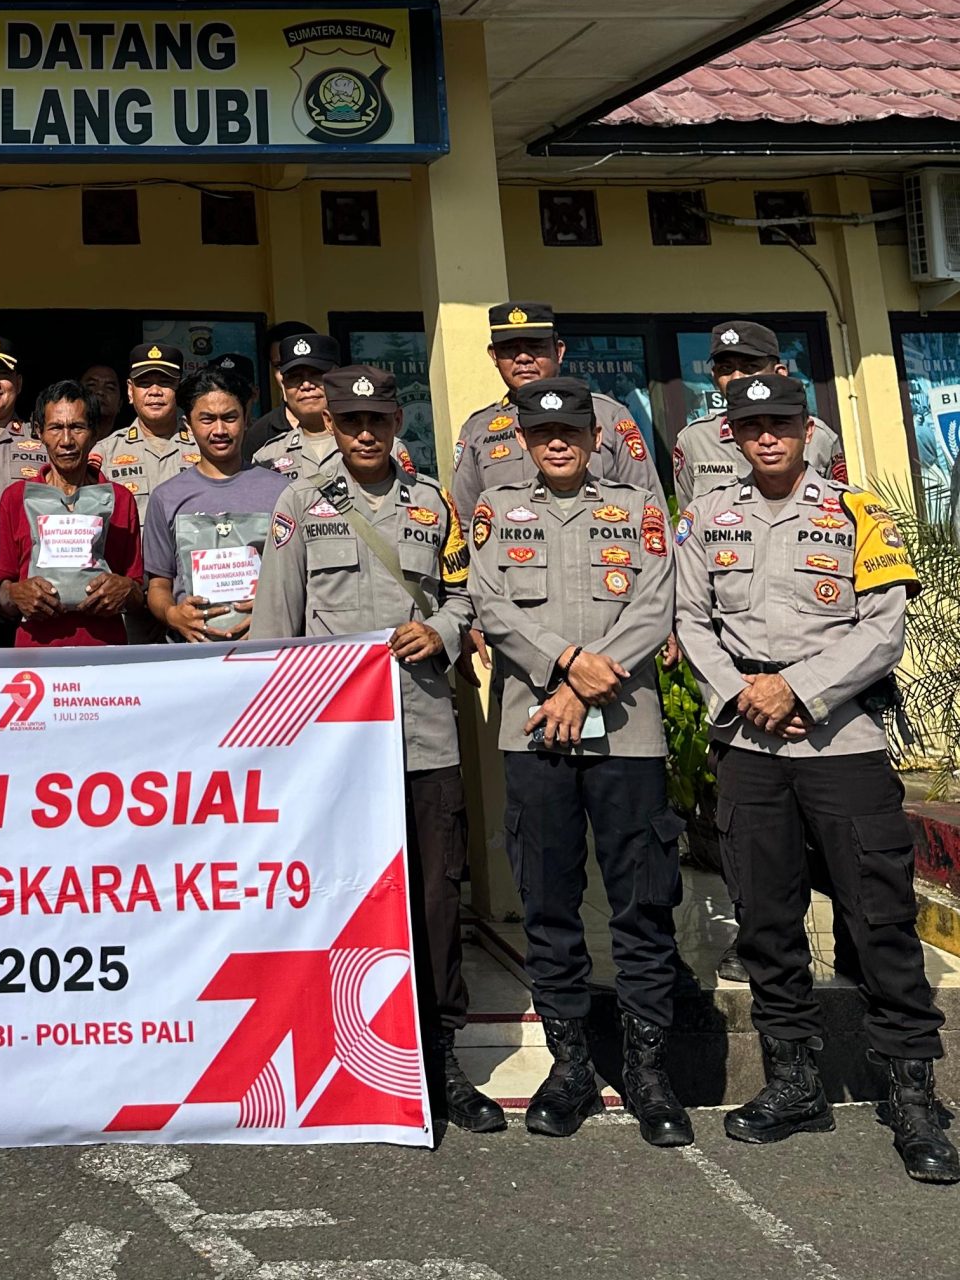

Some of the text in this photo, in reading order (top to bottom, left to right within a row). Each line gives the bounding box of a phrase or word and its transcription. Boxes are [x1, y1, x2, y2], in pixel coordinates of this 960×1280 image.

[288, 25, 390, 43] SUMATERA SELATAN
[7, 22, 236, 71] DATANG
[173, 88, 270, 146] UBI
[569, 361, 633, 373] RESKRIM
[12, 453, 47, 462] POLRI
[112, 466, 143, 478] BENI
[698, 464, 734, 474] IRAWAN
[306, 522, 350, 537] HENDRICK
[500, 527, 545, 540] IKROM
[590, 527, 638, 540] POLRI
[704, 529, 753, 543] DENI.HR
[797, 530, 853, 547] POLRI
[202, 560, 254, 571] BANTUAN SOSIAL
[53, 682, 81, 692] HARI
[53, 696, 142, 707] BHAYANGKARA
[59, 713, 77, 721] JULI
[79, 712, 100, 720] 2025
[31, 770, 279, 829] SOSIAL
[174, 861, 312, 912] KE-79
[36, 1022, 133, 1046] POLRES
[141, 1020, 194, 1044] PALI
